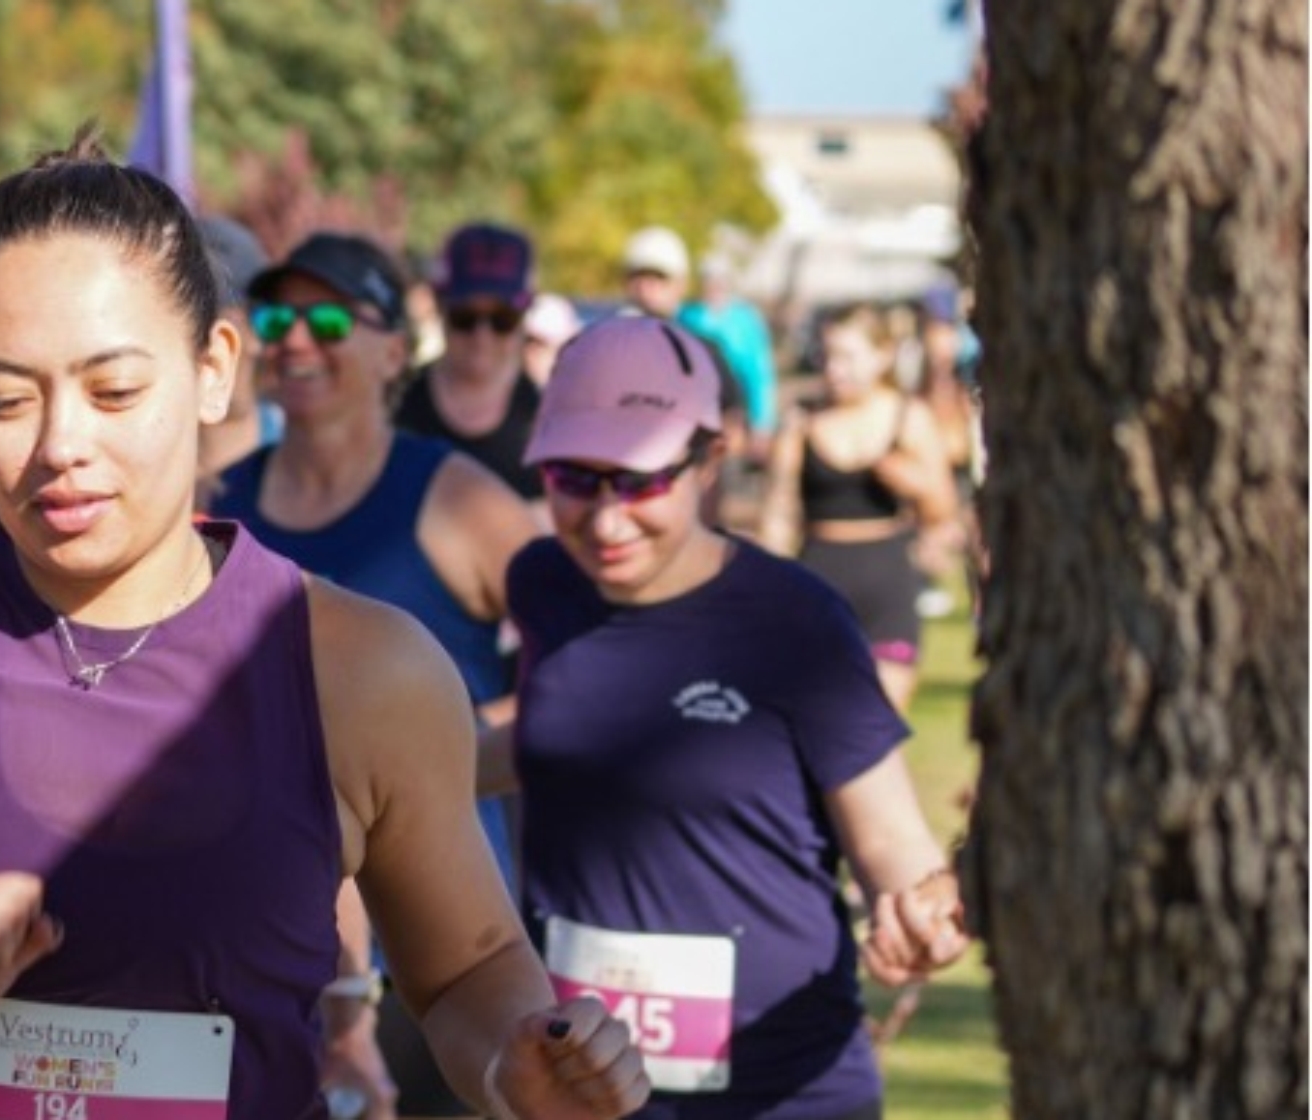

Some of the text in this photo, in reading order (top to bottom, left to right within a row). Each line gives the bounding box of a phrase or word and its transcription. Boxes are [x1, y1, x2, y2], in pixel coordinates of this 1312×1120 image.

[0, 1012, 114, 1049] Vestrum
[14, 1053, 117, 1077] WOMEN'S
[12, 1070, 50, 1087] FUN
[33, 1092, 88, 1120] 194
